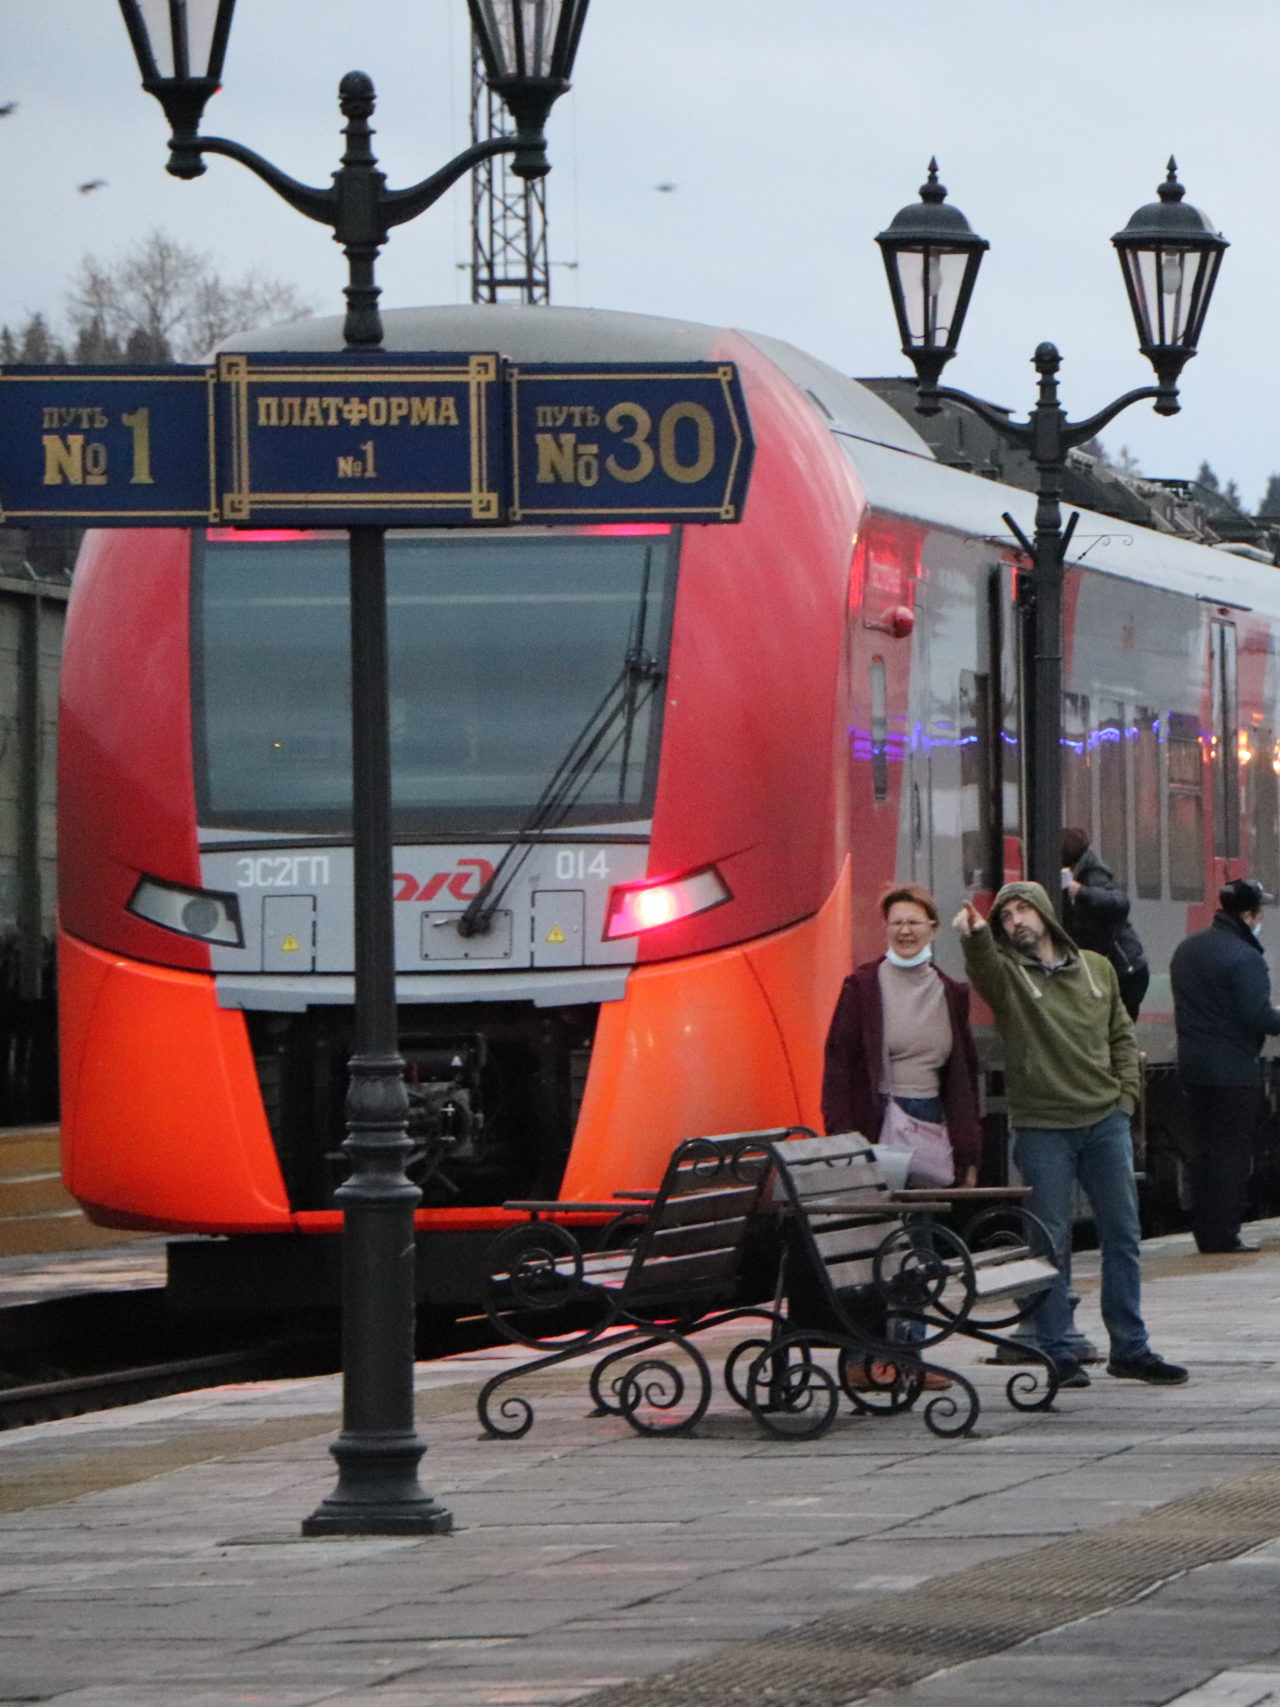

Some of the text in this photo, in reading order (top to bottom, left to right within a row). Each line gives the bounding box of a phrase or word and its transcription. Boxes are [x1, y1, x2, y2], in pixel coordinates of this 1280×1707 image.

[42, 406, 109, 430] ПУТЬ
[256, 396, 460, 427] ПЛАТФОРМА
[535, 405, 600, 428] ПУТЬ
[556, 849, 610, 880] 014
